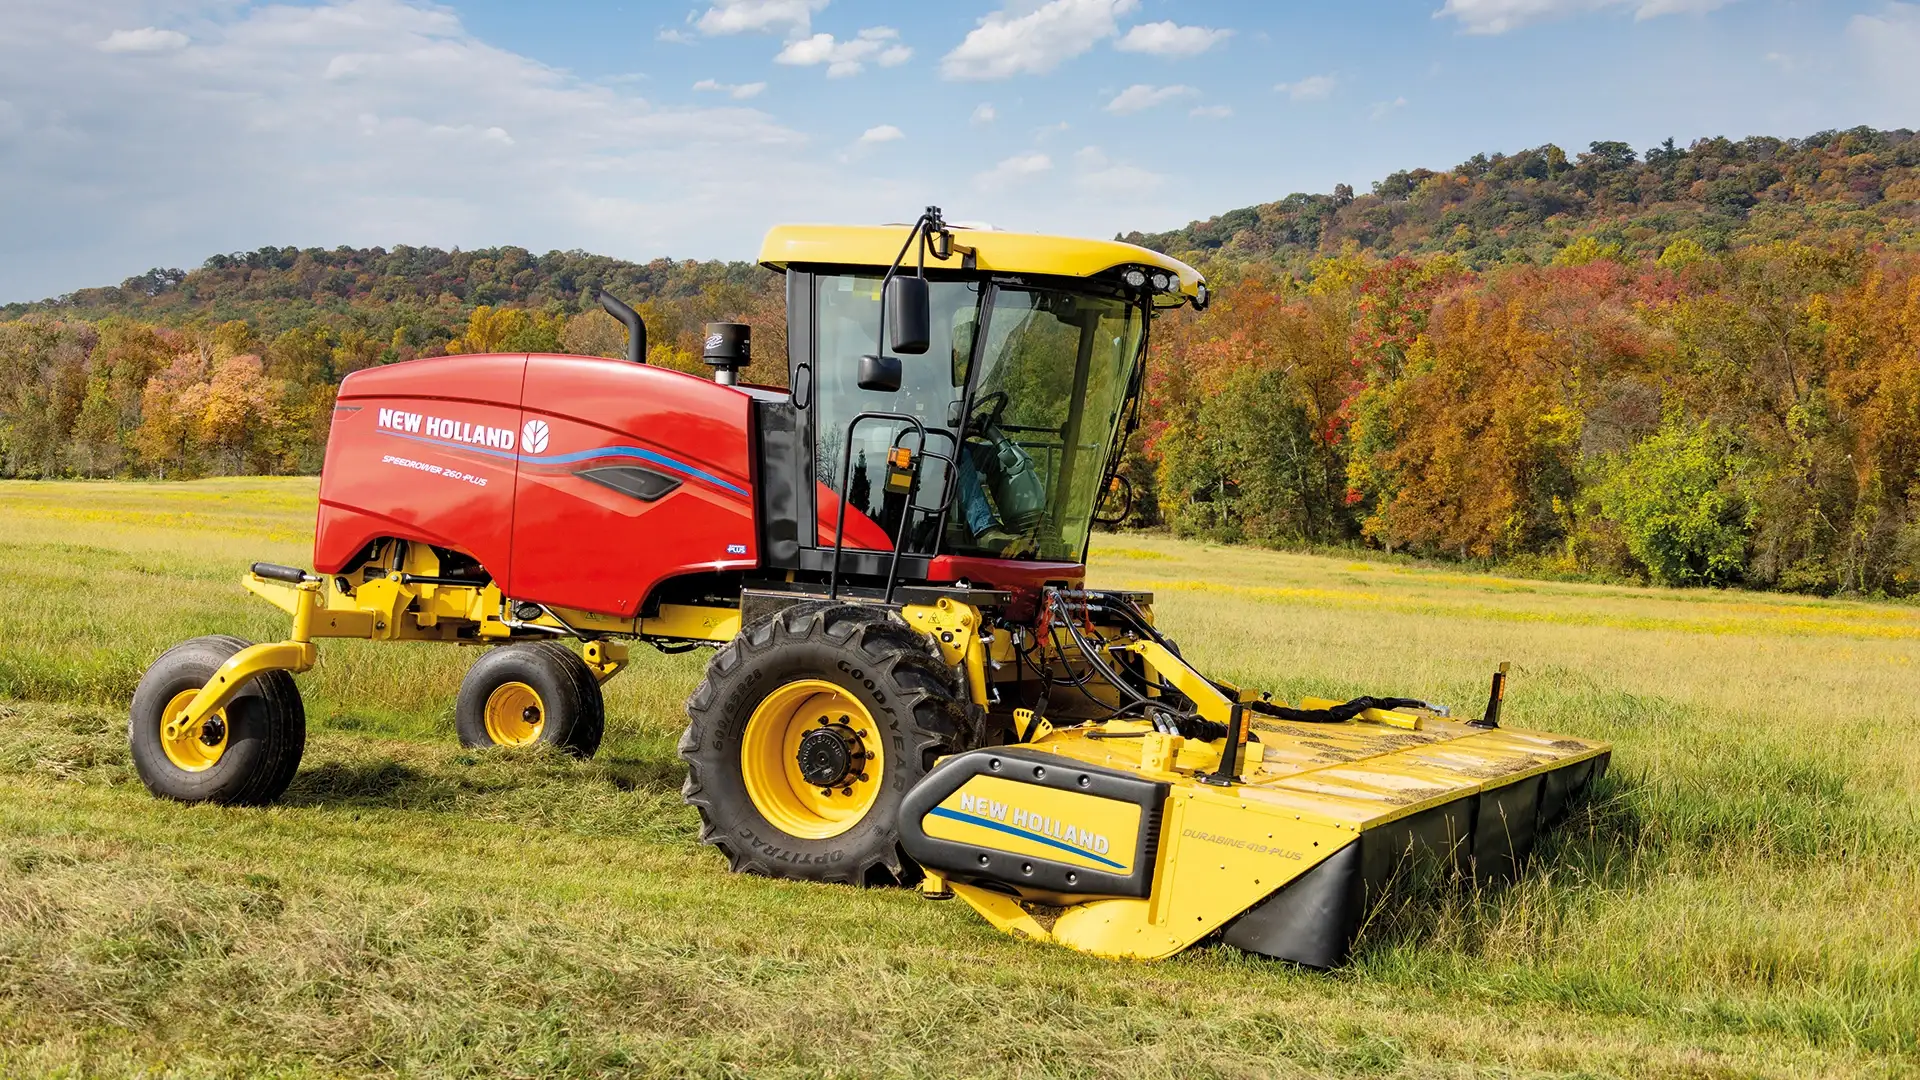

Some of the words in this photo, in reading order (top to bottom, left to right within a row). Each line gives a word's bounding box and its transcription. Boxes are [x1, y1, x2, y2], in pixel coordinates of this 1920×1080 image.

[378, 408, 423, 433] NEW
[426, 416, 515, 450] HOLLAND
[381, 455, 443, 475] SPEEDROWER
[442, 468, 462, 480] 260
[837, 659, 907, 793] GOODYEAR
[959, 792, 1009, 821] NEW
[1012, 807, 1110, 855] HOLLAND
[1182, 828, 1246, 849] DURABINE
[1246, 842, 1268, 853] 419
[739, 828, 845, 865] OPTITRAC
